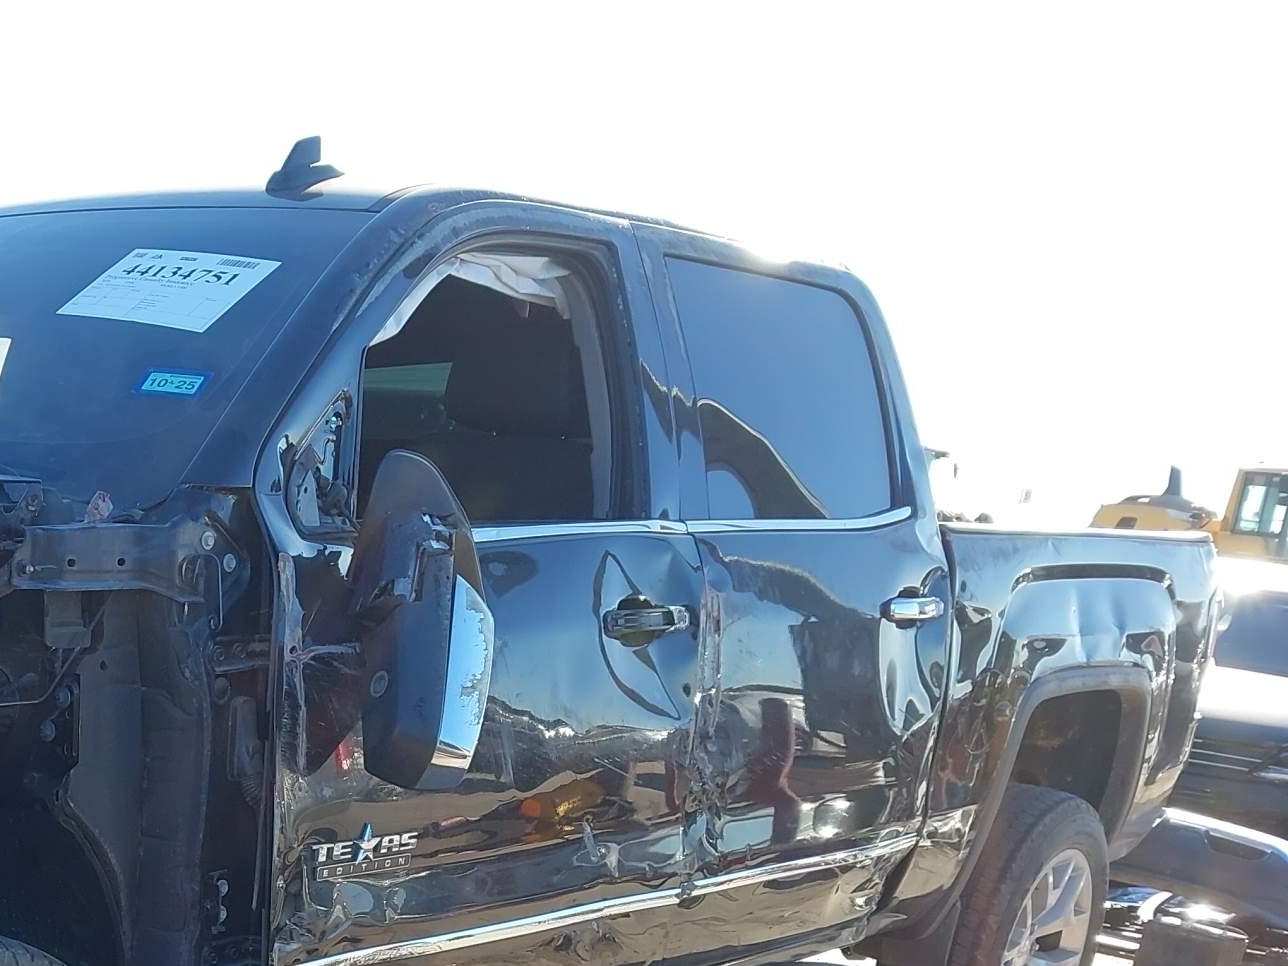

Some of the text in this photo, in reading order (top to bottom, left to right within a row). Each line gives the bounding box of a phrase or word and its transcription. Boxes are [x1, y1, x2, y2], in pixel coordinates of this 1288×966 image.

[122, 263, 240, 286] 44134751
[312, 823, 418, 865] TEXAS
[322, 857, 405, 877] EDITION
